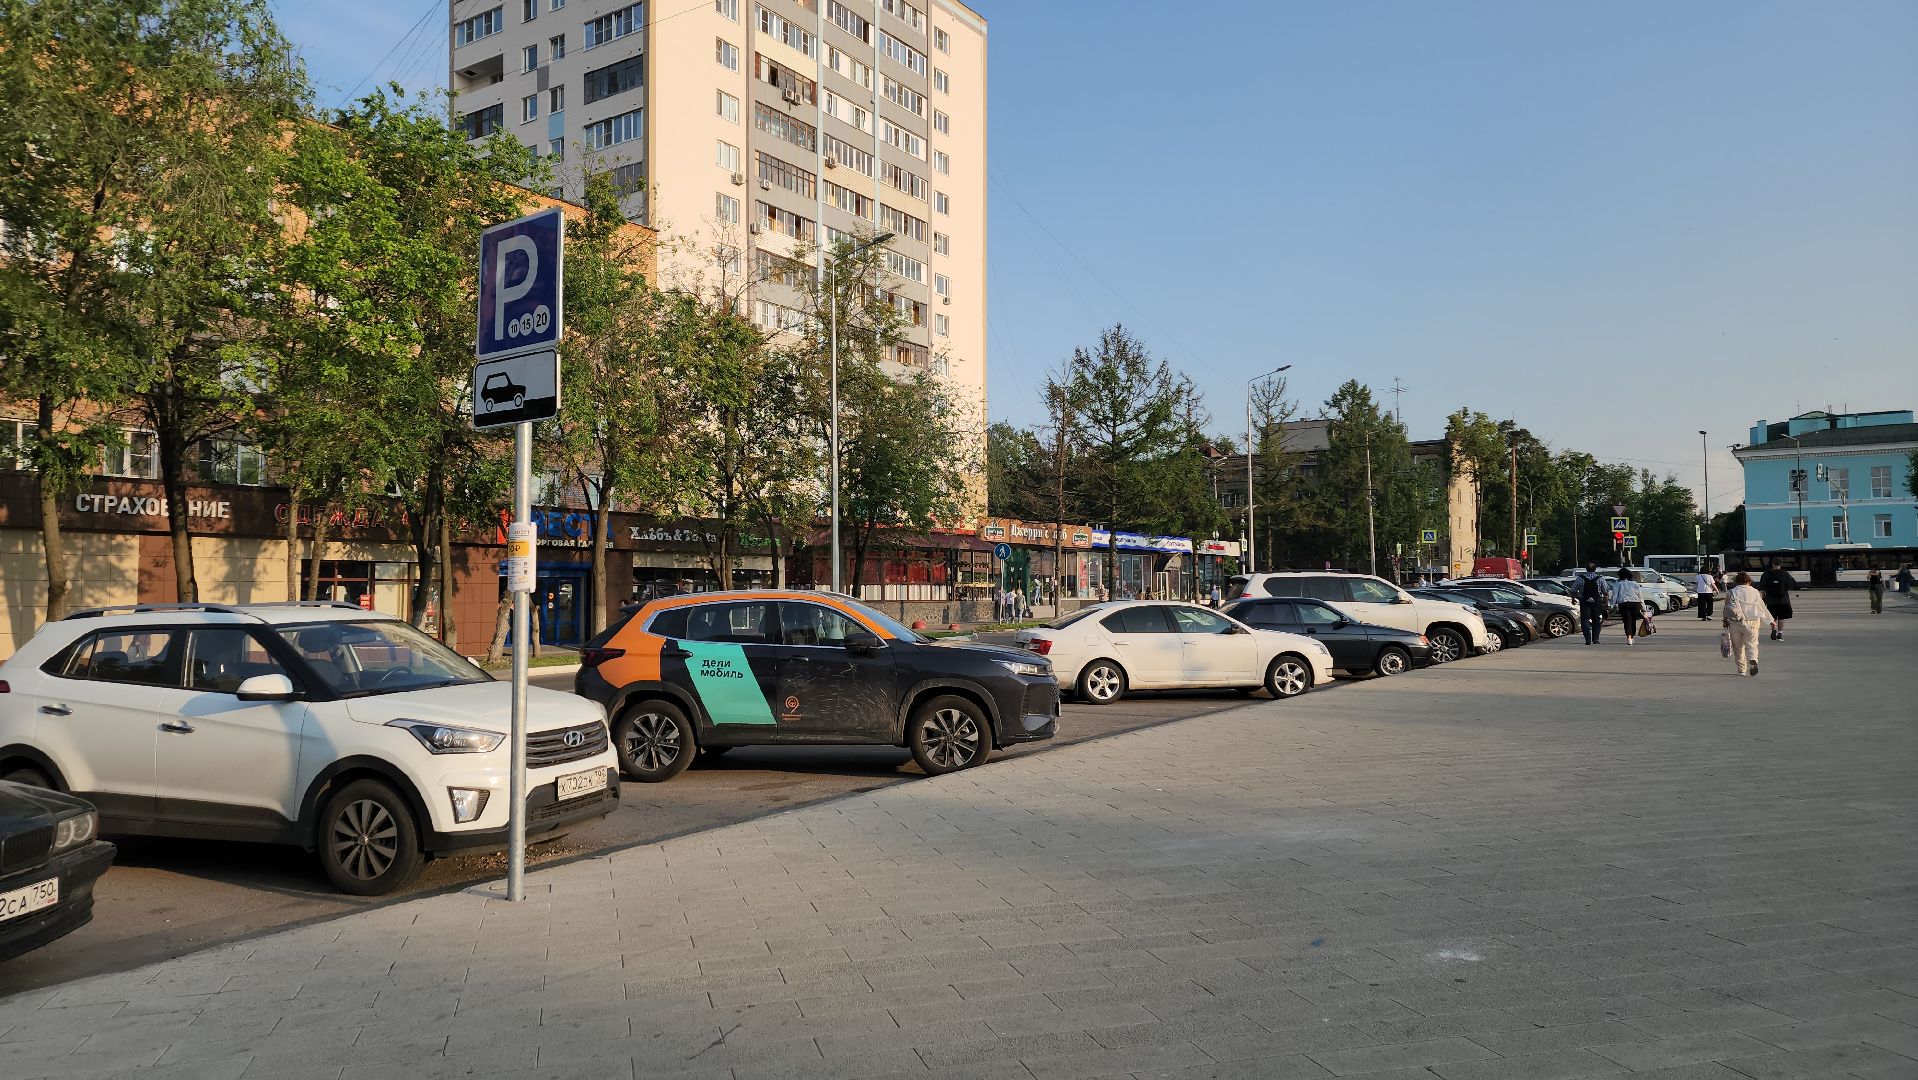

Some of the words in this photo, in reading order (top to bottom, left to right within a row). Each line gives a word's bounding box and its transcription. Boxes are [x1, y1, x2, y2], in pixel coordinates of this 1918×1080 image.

[495, 235, 539, 341] P
[511, 324, 518, 334] 10
[522, 319, 531, 331] 15
[536, 312, 547, 328] 20
[75, 493, 230, 519] СТРАХОВНИЕ
[536, 539, 575, 547] ОРГОВАЯ
[700, 668, 744, 679] мобиль
[702, 660, 731, 669] дели
[33, 881, 54, 902] 750
